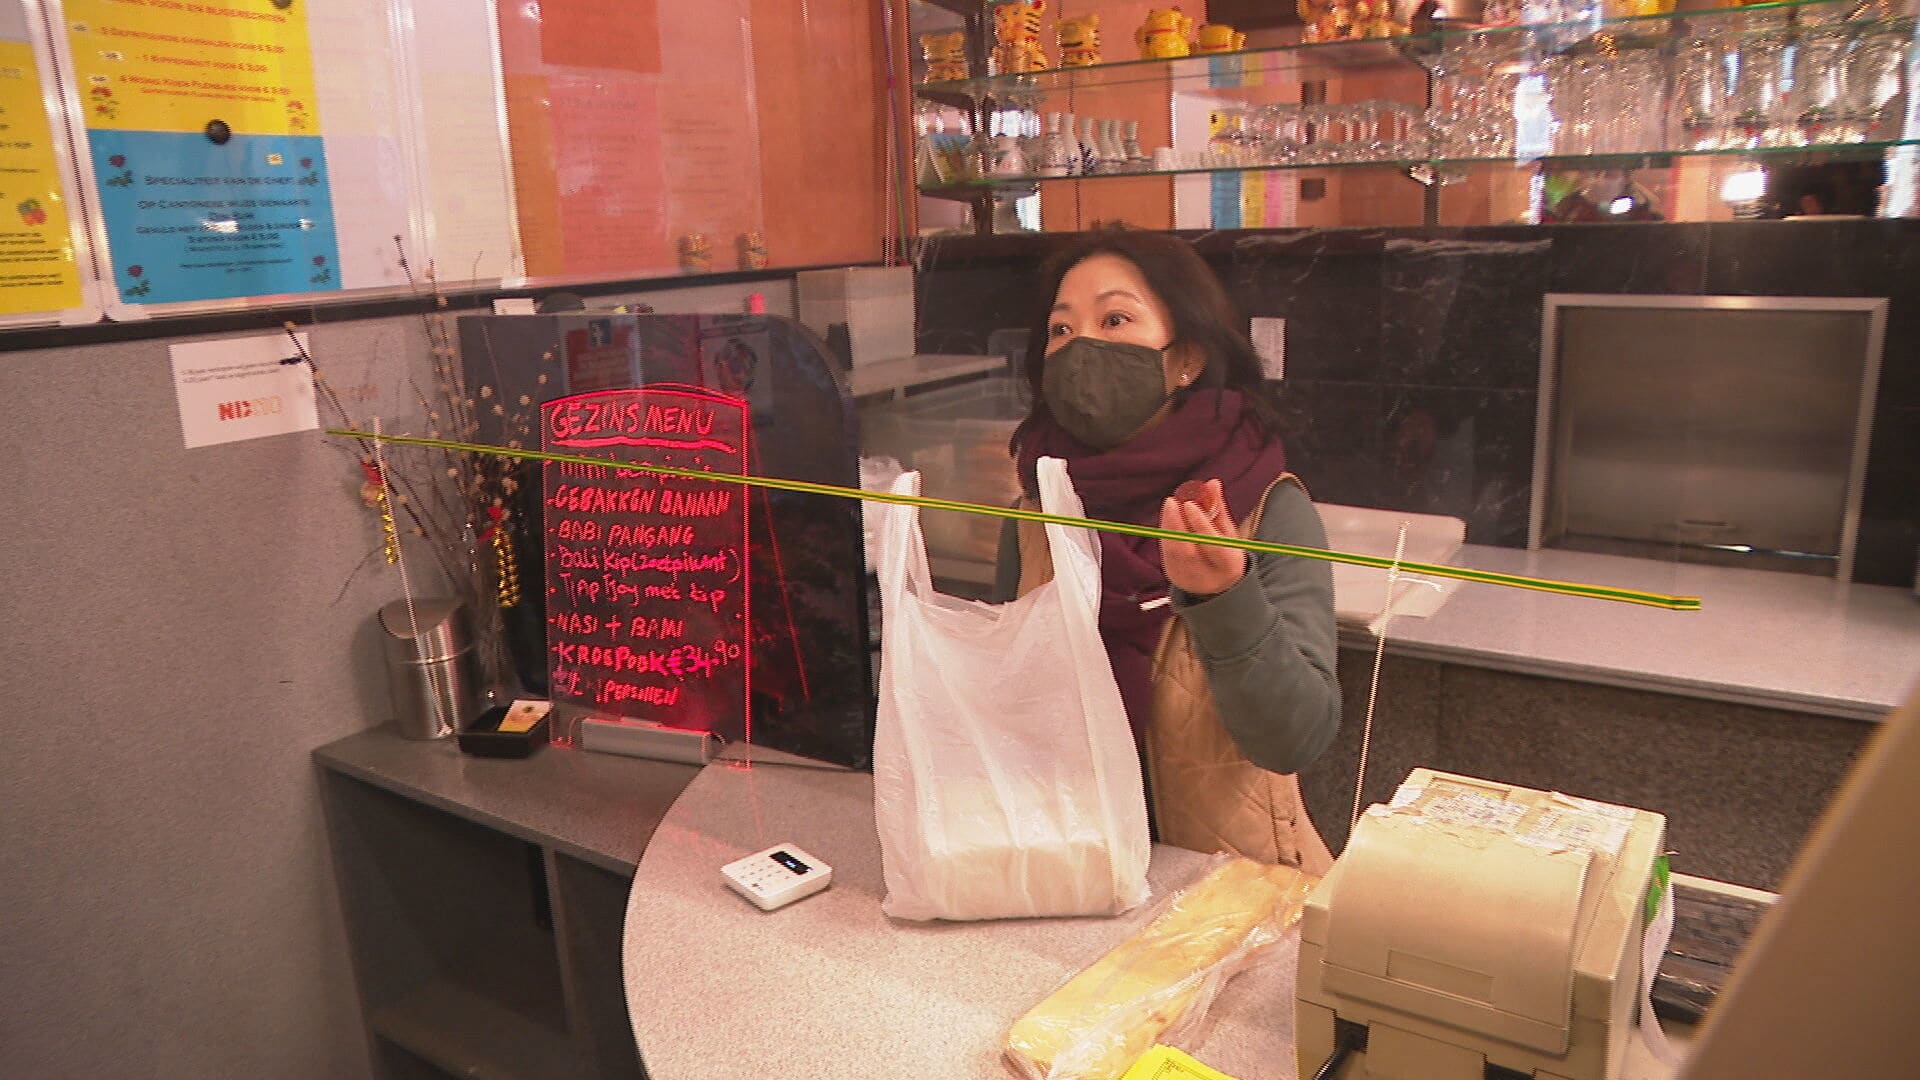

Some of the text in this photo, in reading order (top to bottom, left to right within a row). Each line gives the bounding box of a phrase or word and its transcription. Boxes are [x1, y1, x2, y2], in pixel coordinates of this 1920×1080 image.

[643, 404, 714, 436] MENU
[659, 488, 731, 519] BANAAN
[558, 519, 601, 542] BABI
[607, 524, 695, 549] PANGANG
[630, 616, 684, 640] BAMI
